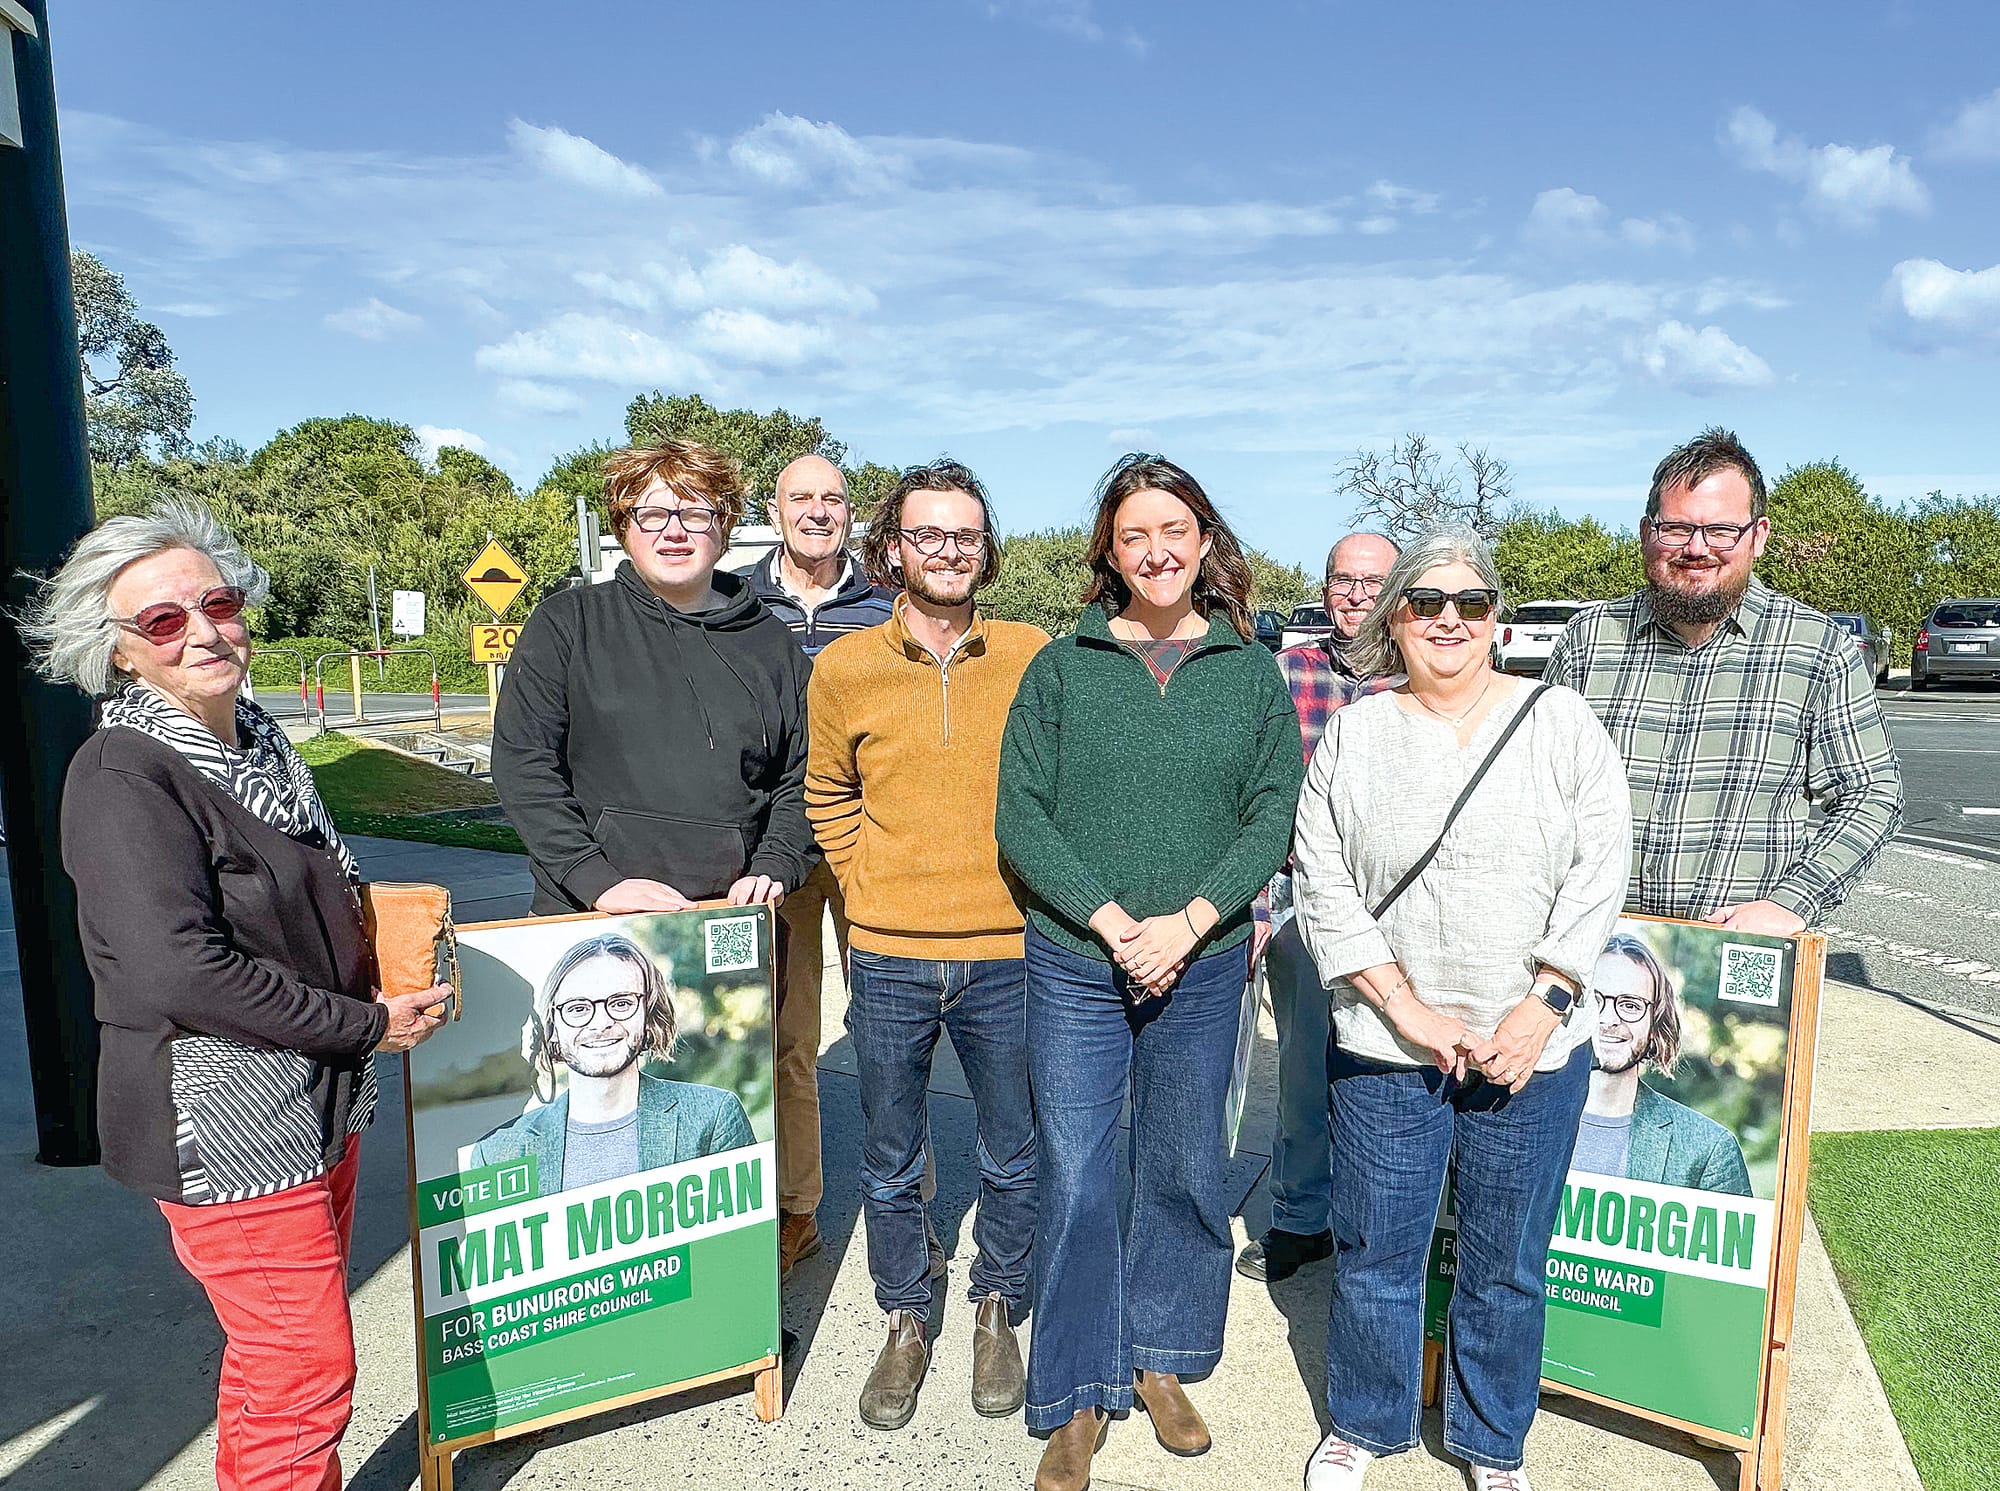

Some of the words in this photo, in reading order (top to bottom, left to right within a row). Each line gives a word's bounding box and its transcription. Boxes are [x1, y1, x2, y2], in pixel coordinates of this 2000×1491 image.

[483, 628, 518, 648] 20
[433, 1179, 491, 1211] VOTE
[437, 1212, 549, 1298] MAT
[566, 1157, 763, 1260] MORGAN
[1552, 1184, 1756, 1270] MORGAN
[441, 1311, 486, 1343] FOR
[492, 1273, 614, 1328] BUNURONG
[619, 1255, 681, 1289] WARD
[1562, 1287, 1622, 1312] COUNCIL
[1593, 1268, 1655, 1297] WARD
[442, 1339, 484, 1365] BASS
[487, 1322, 539, 1350] COAST
[543, 1307, 587, 1333] SHIRE
[590, 1289, 653, 1318] COUNCIL
